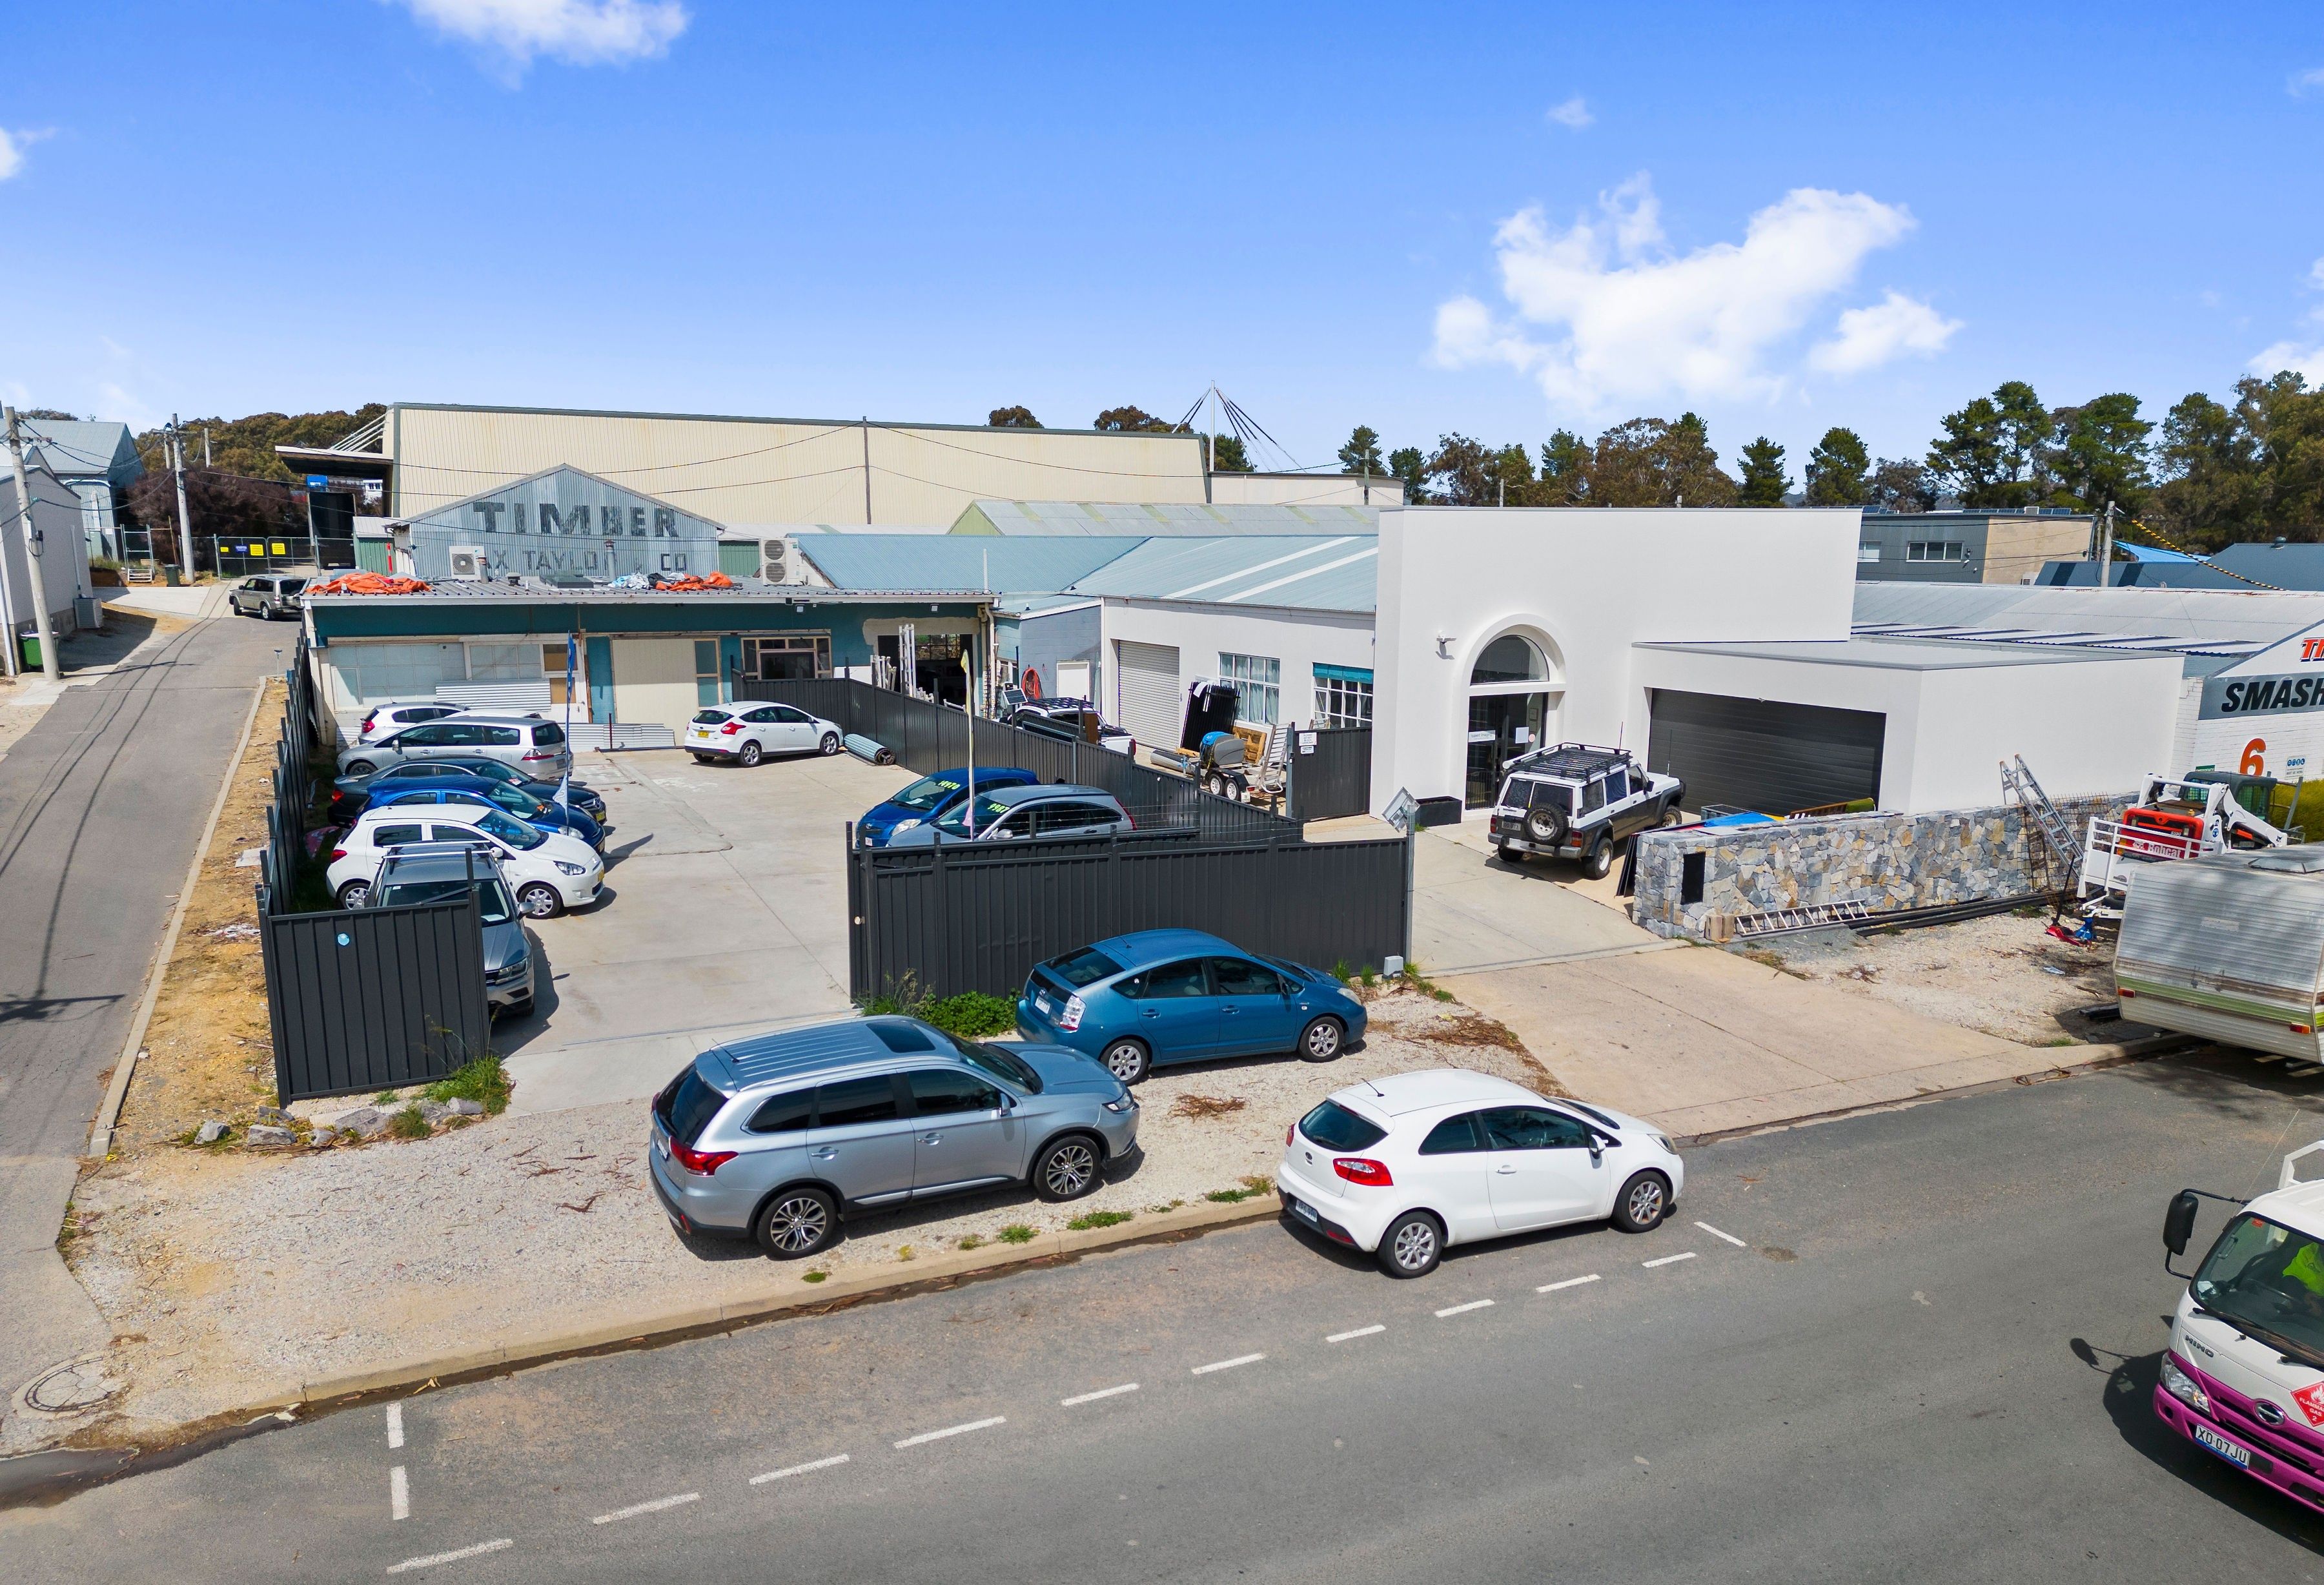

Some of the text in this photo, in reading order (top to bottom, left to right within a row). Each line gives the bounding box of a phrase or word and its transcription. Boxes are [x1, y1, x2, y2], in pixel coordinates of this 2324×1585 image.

[473, 502, 678, 537] TIMBER
[660, 553, 686, 571] CO
[2240, 738, 2267, 776] 6
[2148, 843, 2182, 859] Bobcat
[2185, 1334, 2214, 1358] HINO
[2309, 1407, 2323, 1416] GAS
